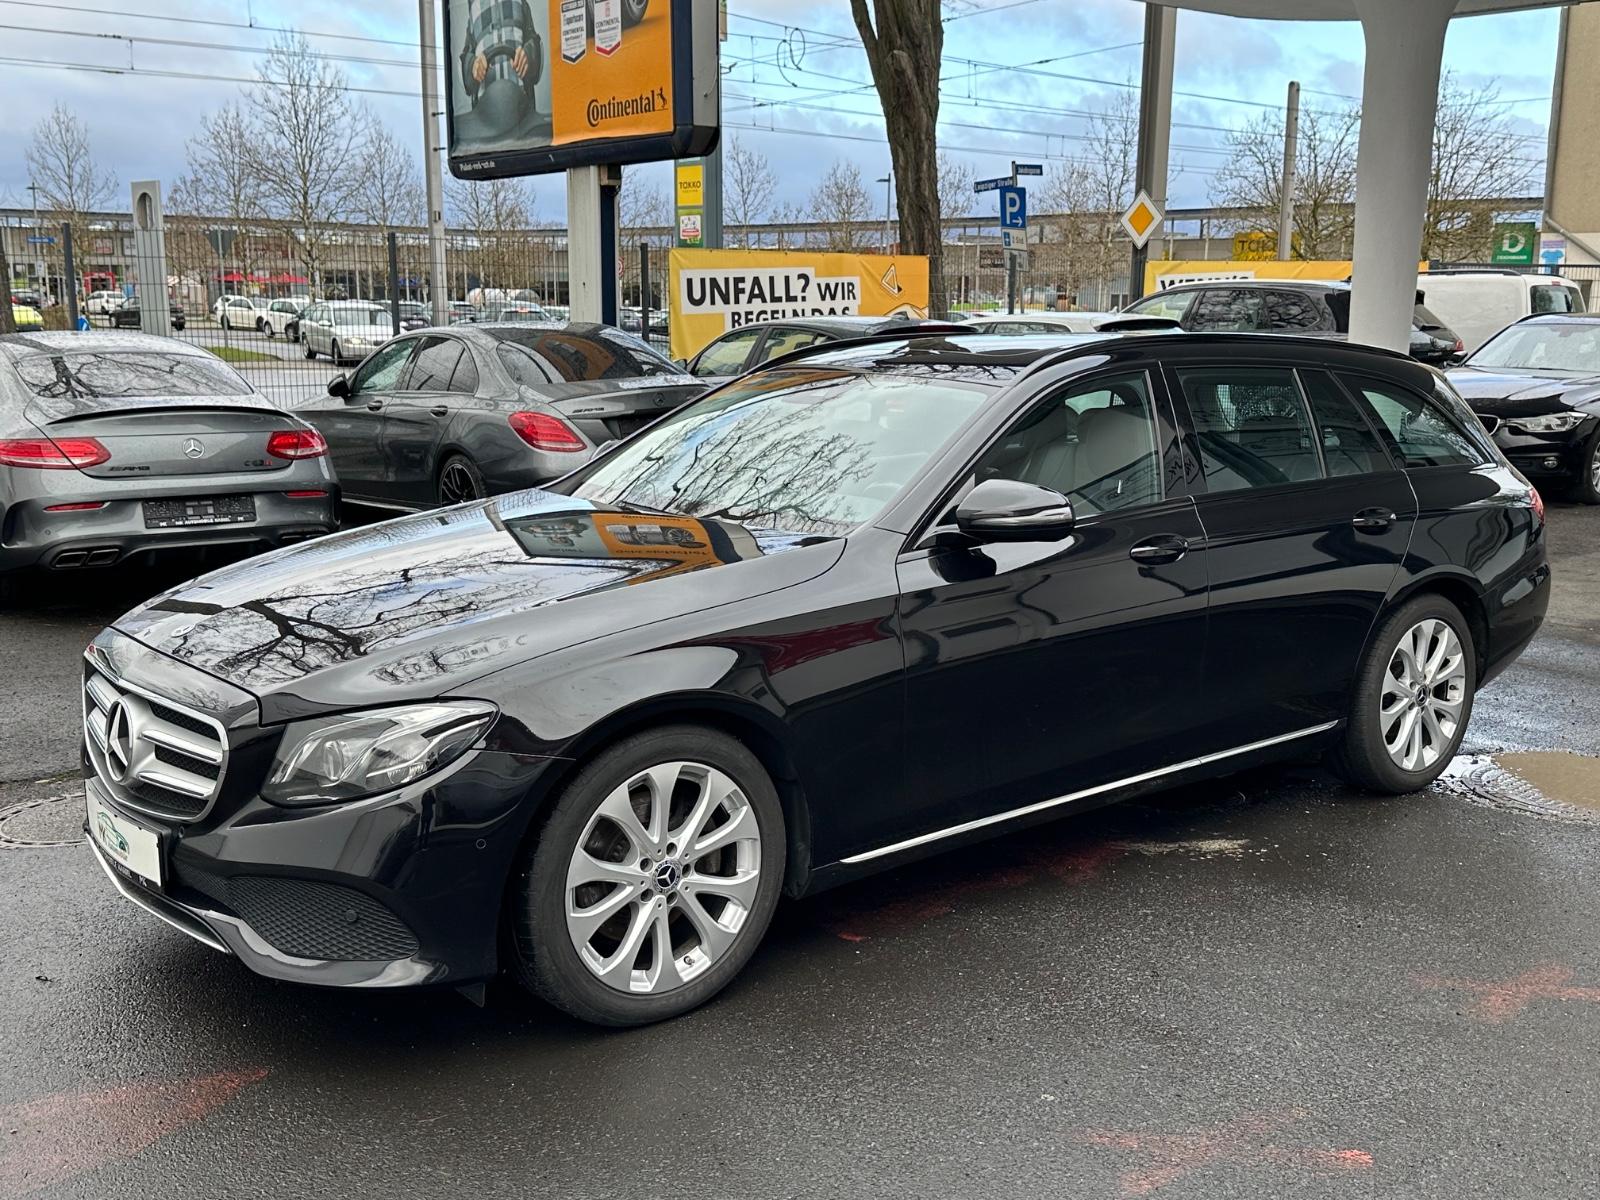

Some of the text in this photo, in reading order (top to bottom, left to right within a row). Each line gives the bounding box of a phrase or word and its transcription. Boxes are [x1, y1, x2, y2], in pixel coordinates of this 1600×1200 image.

[596, 17, 620, 29] CONTINENTAL
[587, 89, 655, 127] Continental
[974, 182, 996, 191] Leipziger
[1006, 192, 1020, 224] P
[1502, 232, 1526, 254] D
[686, 273, 857, 306] UNFALL? WIR
